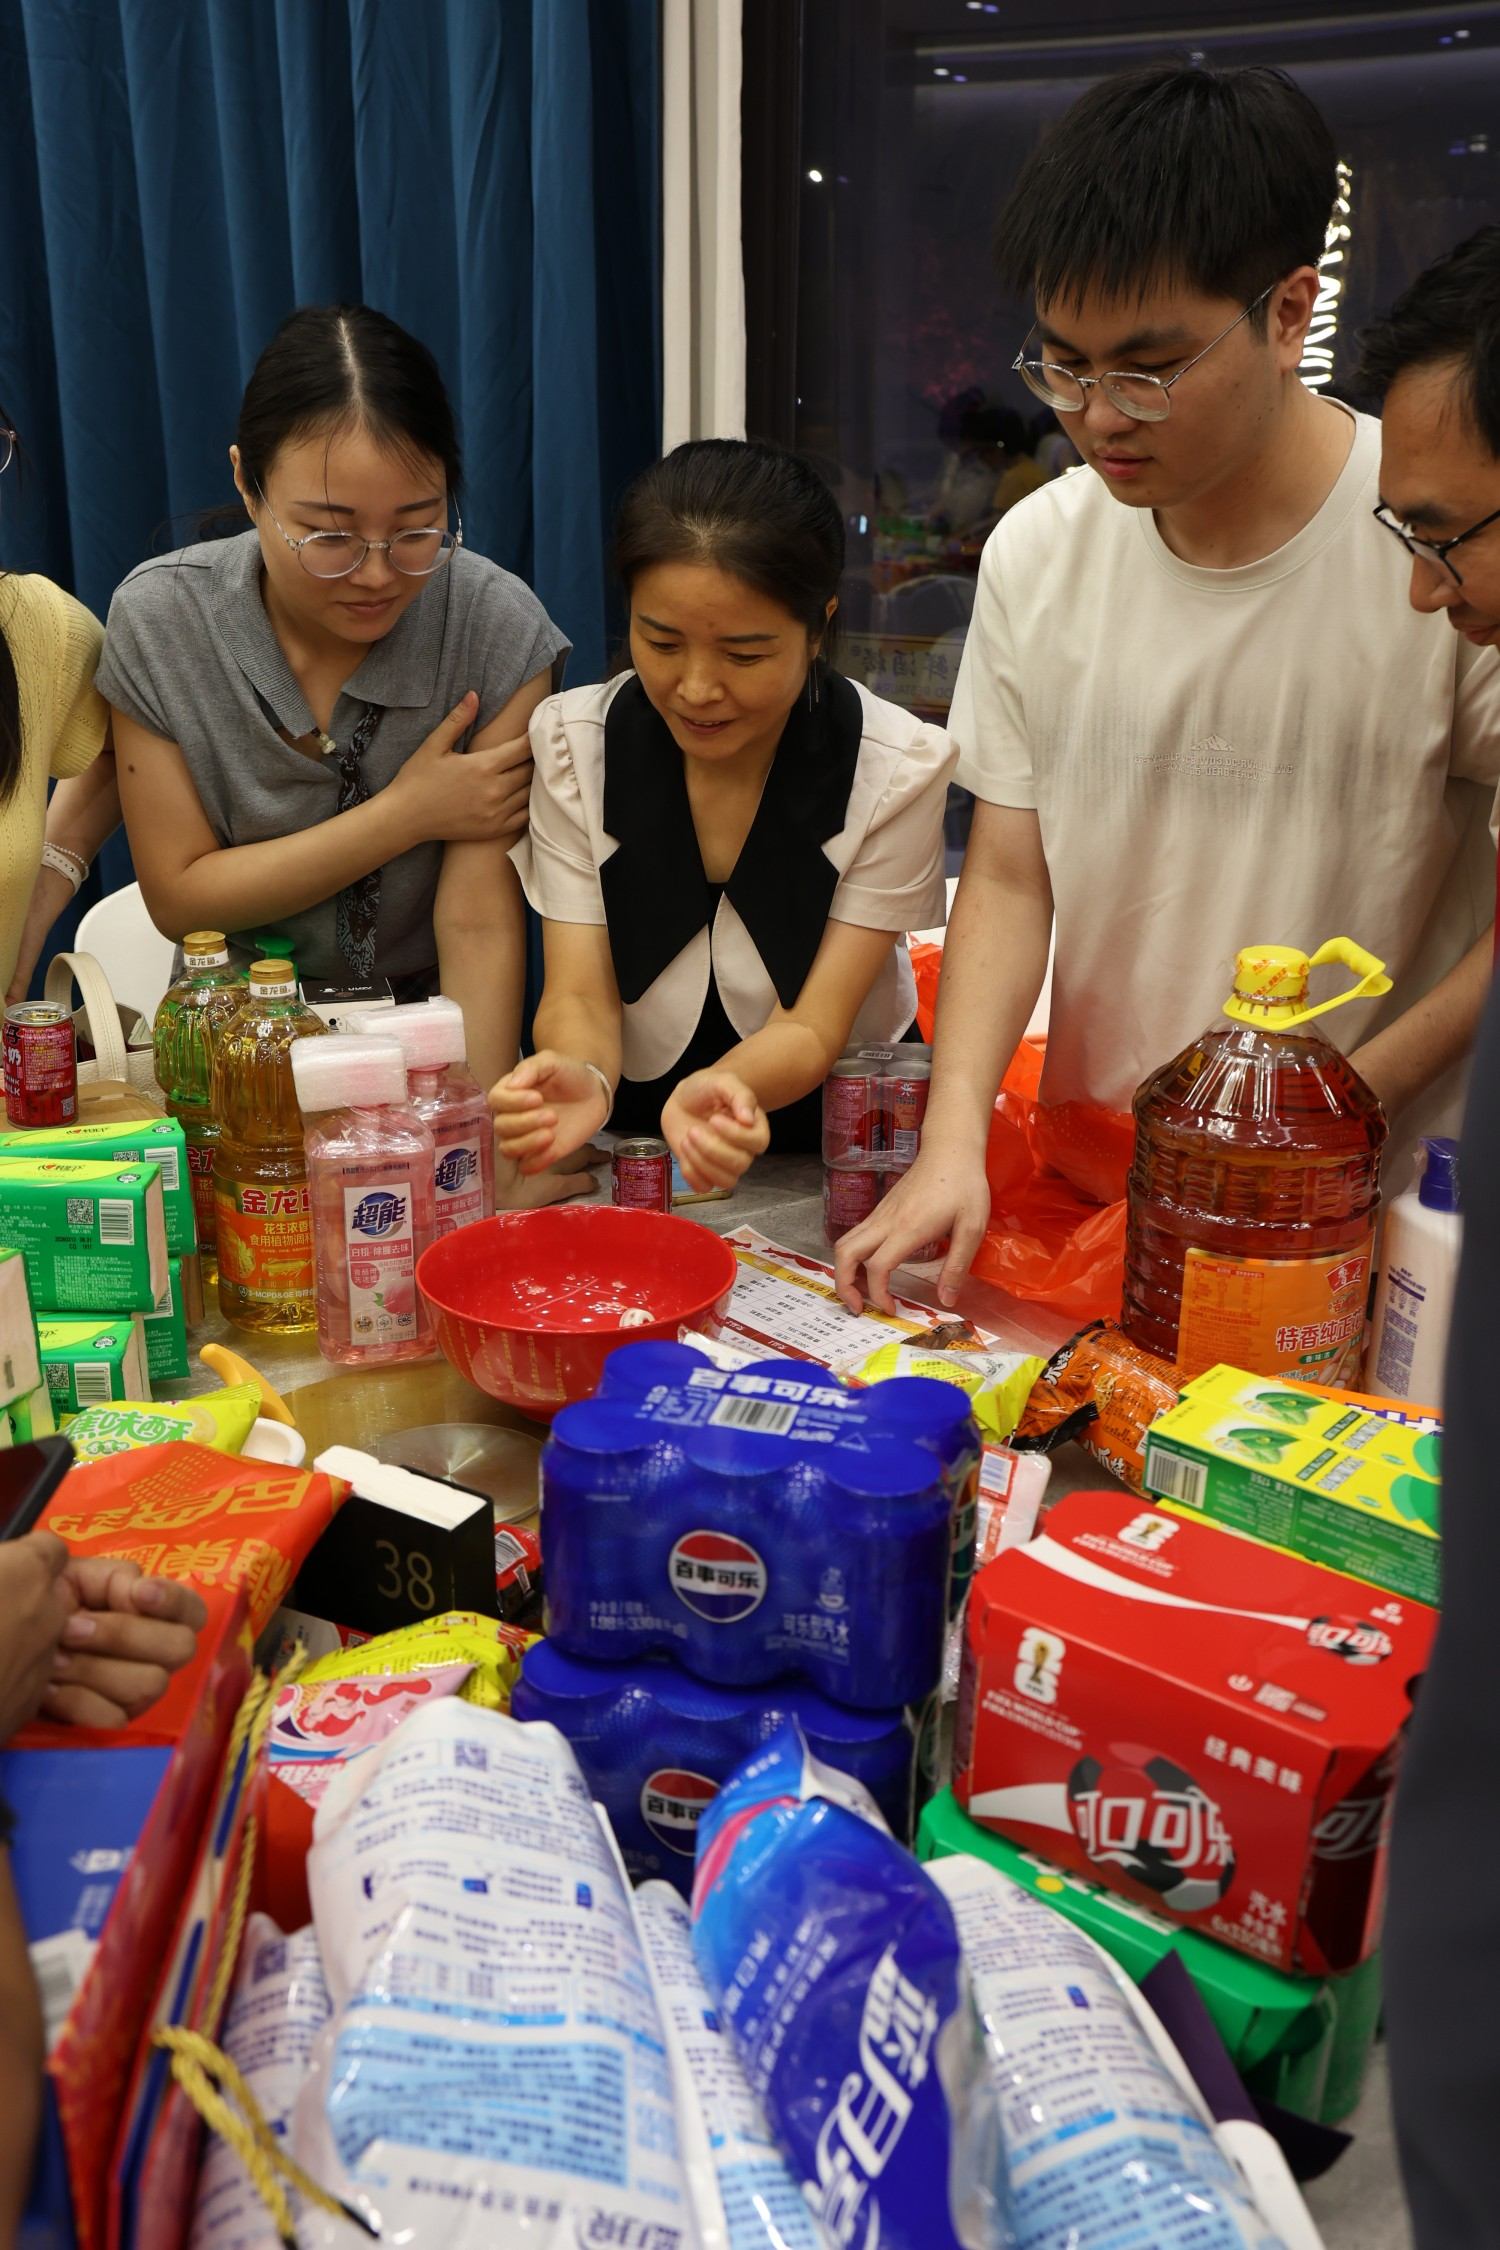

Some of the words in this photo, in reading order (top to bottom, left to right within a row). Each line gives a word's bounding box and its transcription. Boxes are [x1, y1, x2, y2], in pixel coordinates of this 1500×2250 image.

[189, 956, 216, 966] 金龙鱼
[259, 985, 290, 995] 金龙鱼
[352, 1197, 406, 1230] 超能
[687, 1367, 857, 1409] 百事可乐
[375, 1539, 436, 1611] 38
[674, 1561, 761, 1590] 百事可乐
[1204, 1735, 1303, 1794] 经典美味
